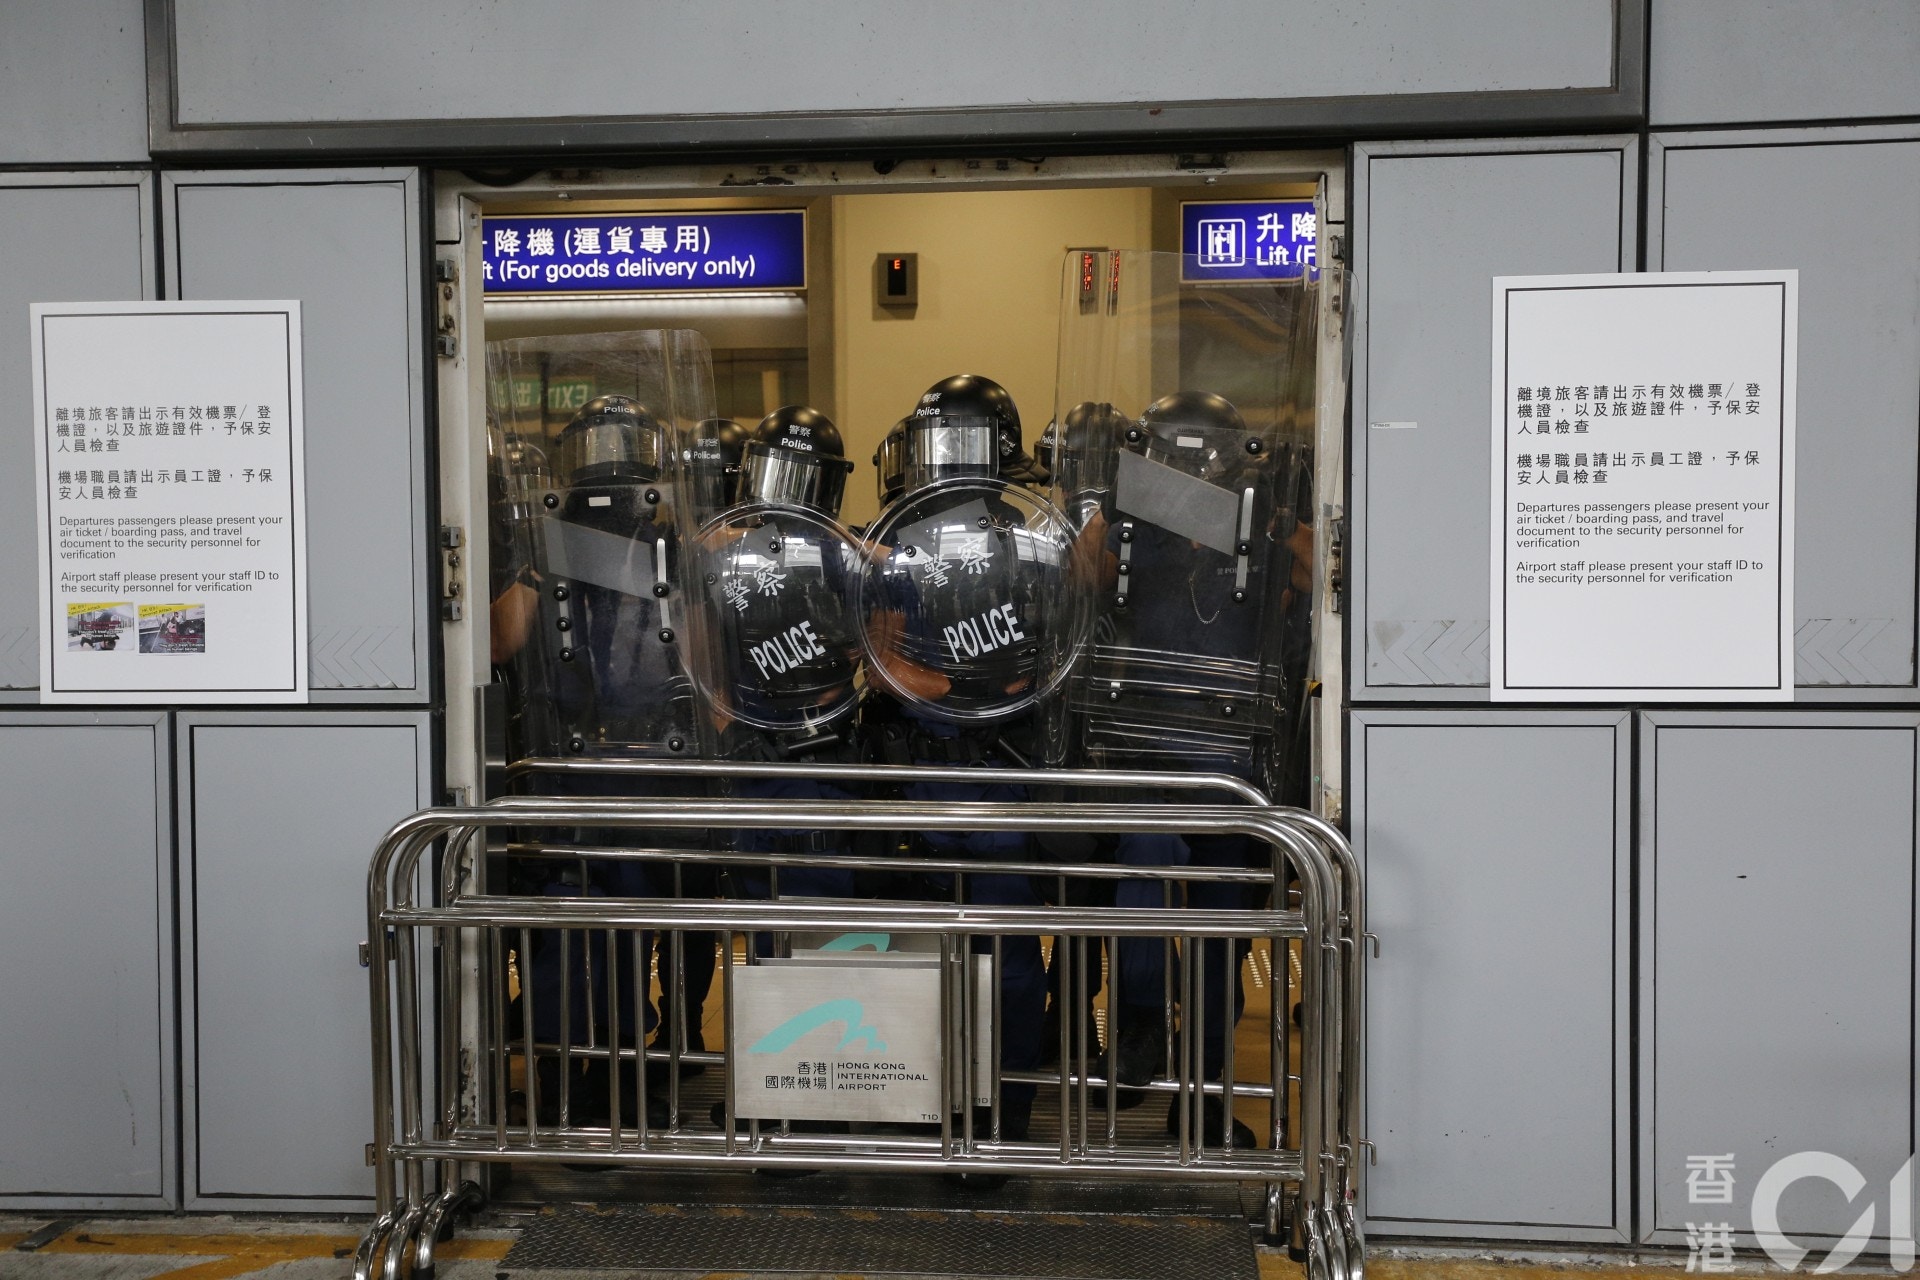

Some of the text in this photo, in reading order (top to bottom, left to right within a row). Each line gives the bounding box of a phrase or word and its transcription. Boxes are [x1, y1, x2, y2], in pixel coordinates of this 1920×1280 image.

[1256, 212, 1316, 244] 升降
[482, 225, 711, 259] 降機(運貨專用)
[1256, 245, 1290, 266] Lift
[500, 260, 540, 282] (For
[545, 260, 610, 283] goods
[616, 257, 698, 280] delivery
[703, 254, 756, 278] only)
[895, 258, 902, 270] E
[604, 405, 636, 414] Police
[916, 406, 941, 418] Police
[1518, 419, 1589, 435] 人員檢查
[58, 438, 119, 452] 人員檢查
[781, 437, 813, 452] Police
[1518, 469, 1608, 485] 安人員檢查
[59, 485, 137, 500] 安人員檢查
[1517, 501, 1769, 514] Departures passengers please present your
[60, 515, 282, 527] Departures passengers please present your
[1517, 514, 1532, 524] air
[1535, 514, 1565, 524] ticket
[1576, 513, 1628, 525] boarding
[1633, 515, 1662, 525] pass,
[1666, 513, 1687, 523] and
[1692, 512, 1723, 522] travel
[60, 528, 72, 537] air
[76, 527, 102, 537] ticket
[111, 527, 157, 538] boarding
[161, 529, 187, 538] pass,
[190, 526, 210, 536] and
[213, 526, 242, 535] travel
[1517, 524, 1744, 537] document to the security personnel for
[60, 537, 261, 549] document to the security personnel for
[1516, 537, 1580, 547] verification
[60, 550, 115, 559] verification
[922, 536, 995, 589] 警察
[1516, 560, 1763, 573] Airport staff please present your staff ID to
[61, 571, 279, 583] Airport staff please present your staff ID to
[1516, 572, 1732, 585] the security personnel for verification
[61, 582, 252, 594] the security personnel for verification
[722, 560, 787, 612] 警察
[944, 602, 1025, 664] POLICE
[750, 620, 826, 681] POLICE
[798, 1062, 827, 1075] 香港
[765, 1075, 827, 1090] 國際機場
